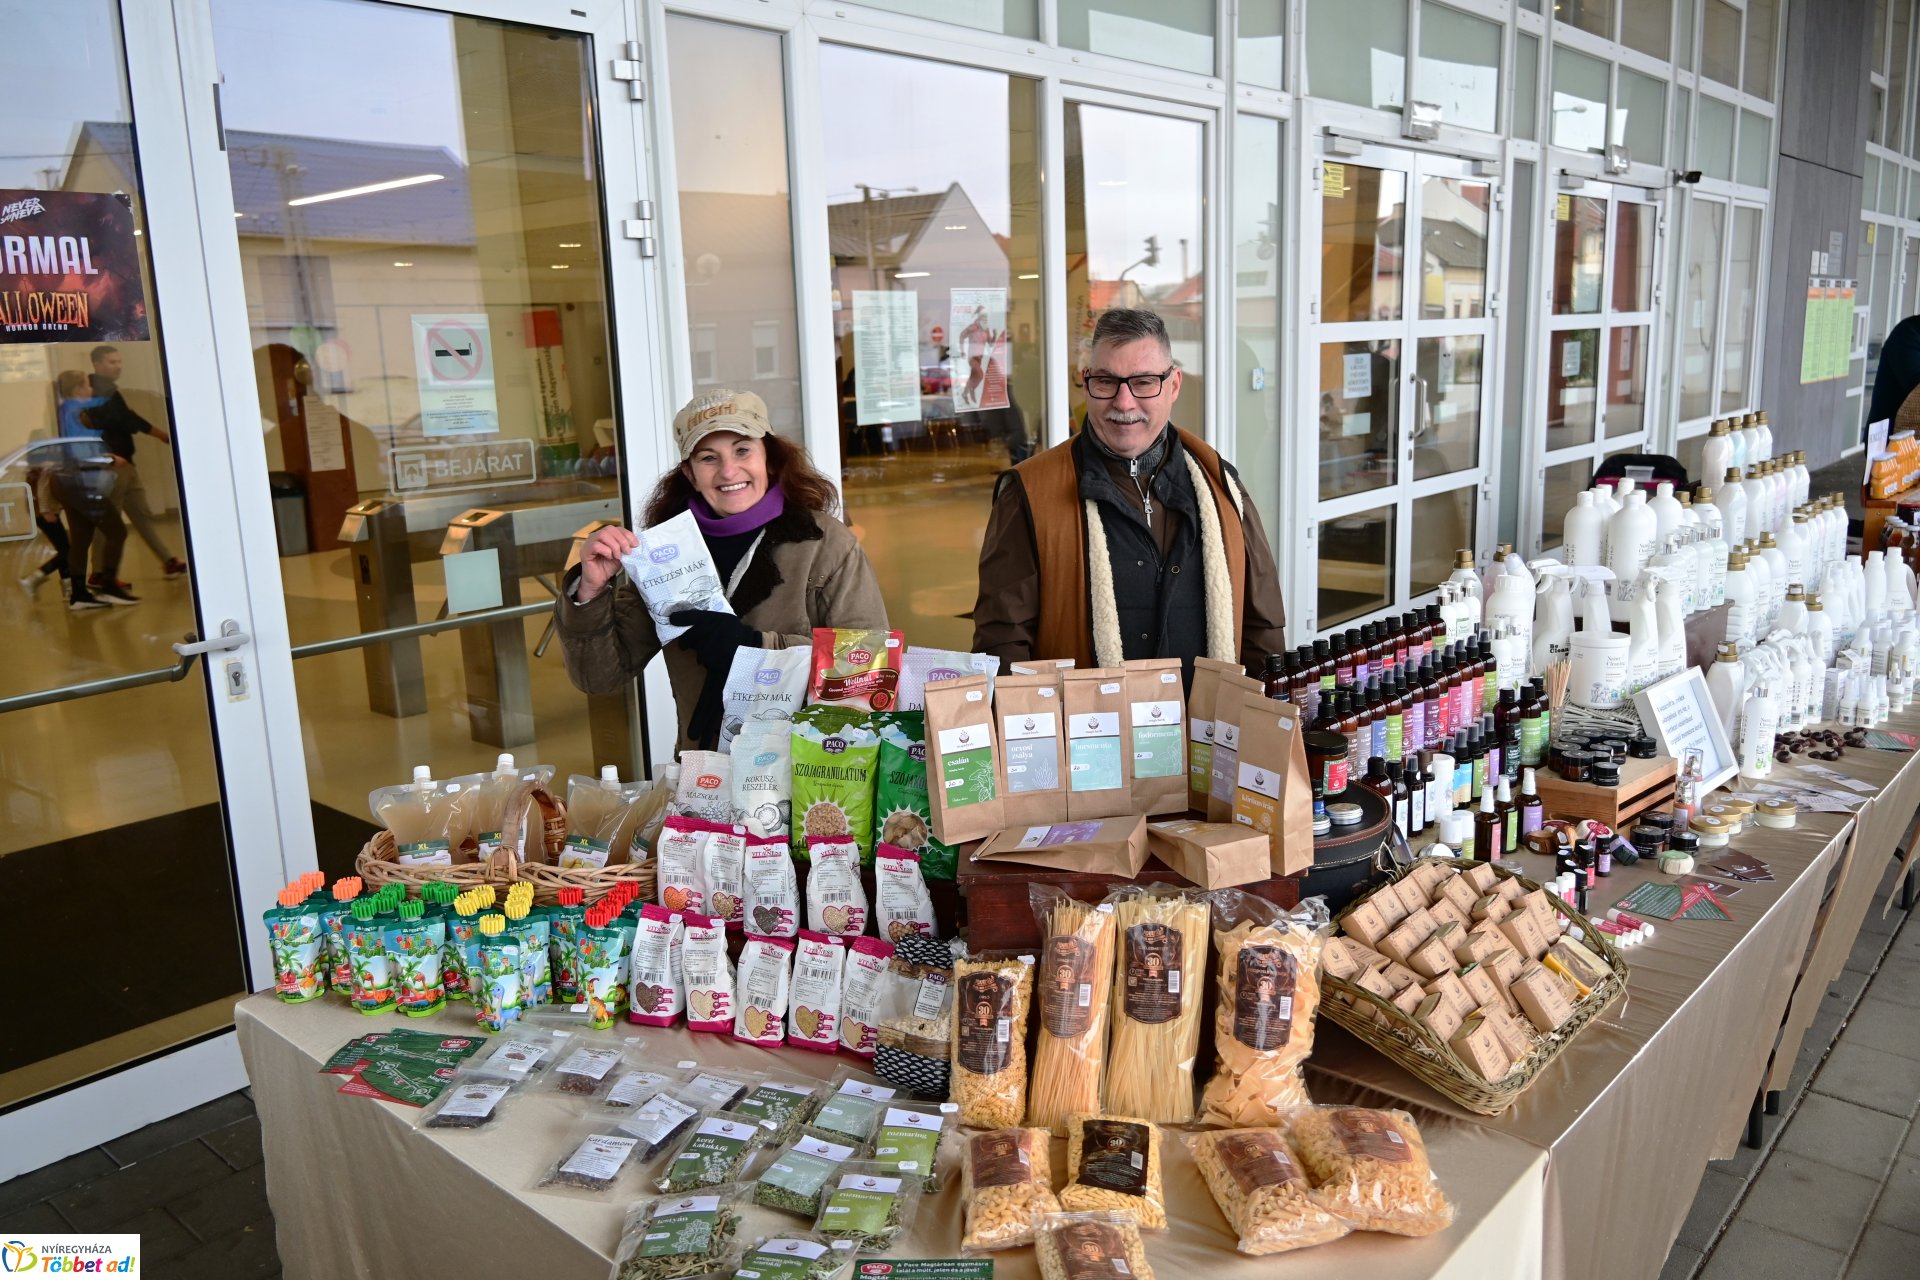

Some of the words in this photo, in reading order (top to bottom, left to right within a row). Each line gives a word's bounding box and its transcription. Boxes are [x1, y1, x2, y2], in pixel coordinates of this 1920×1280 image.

[2, 197, 45, 216] NEVER
[0, 236, 98, 275] RMAL
[5, 323, 39, 332] HORROR
[42, 323, 68, 332] ARENA
[435, 453, 524, 477] BEJÁRAT
[652, 546, 676, 560] PACO
[641, 568, 683, 590] ÉTKEZÉSI
[685, 559, 706, 576] MÁK
[850, 652, 869, 660] PACO
[757, 672, 779, 680] PACO
[931, 671, 958, 680] PACO
[732, 692, 769, 702] ÉTKEZÉSI
[770, 693, 792, 702] MÁK
[825, 740, 844, 749] PACO
[911, 747, 926, 756] PAC
[757, 754, 776, 762] PACO
[947, 757, 969, 767] csalán
[795, 763, 867, 782] SZÓJAGRANULÁTUM
[699, 777, 719, 786] PACO
[685, 791, 719, 800] MAZSOLA
[1147, 956, 1159, 966] 30
[928, 974, 945, 982] PACO
[1059, 969, 1071, 979] 30
[1259, 980, 1272, 990] 30
[978, 1005, 990, 1015] 30
[886, 1130, 928, 1140] rozmaring
[588, 1137, 633, 1147] Kardamom
[692, 1141, 728, 1152] kakukkfű
[1109, 1138, 1124, 1147] 30
